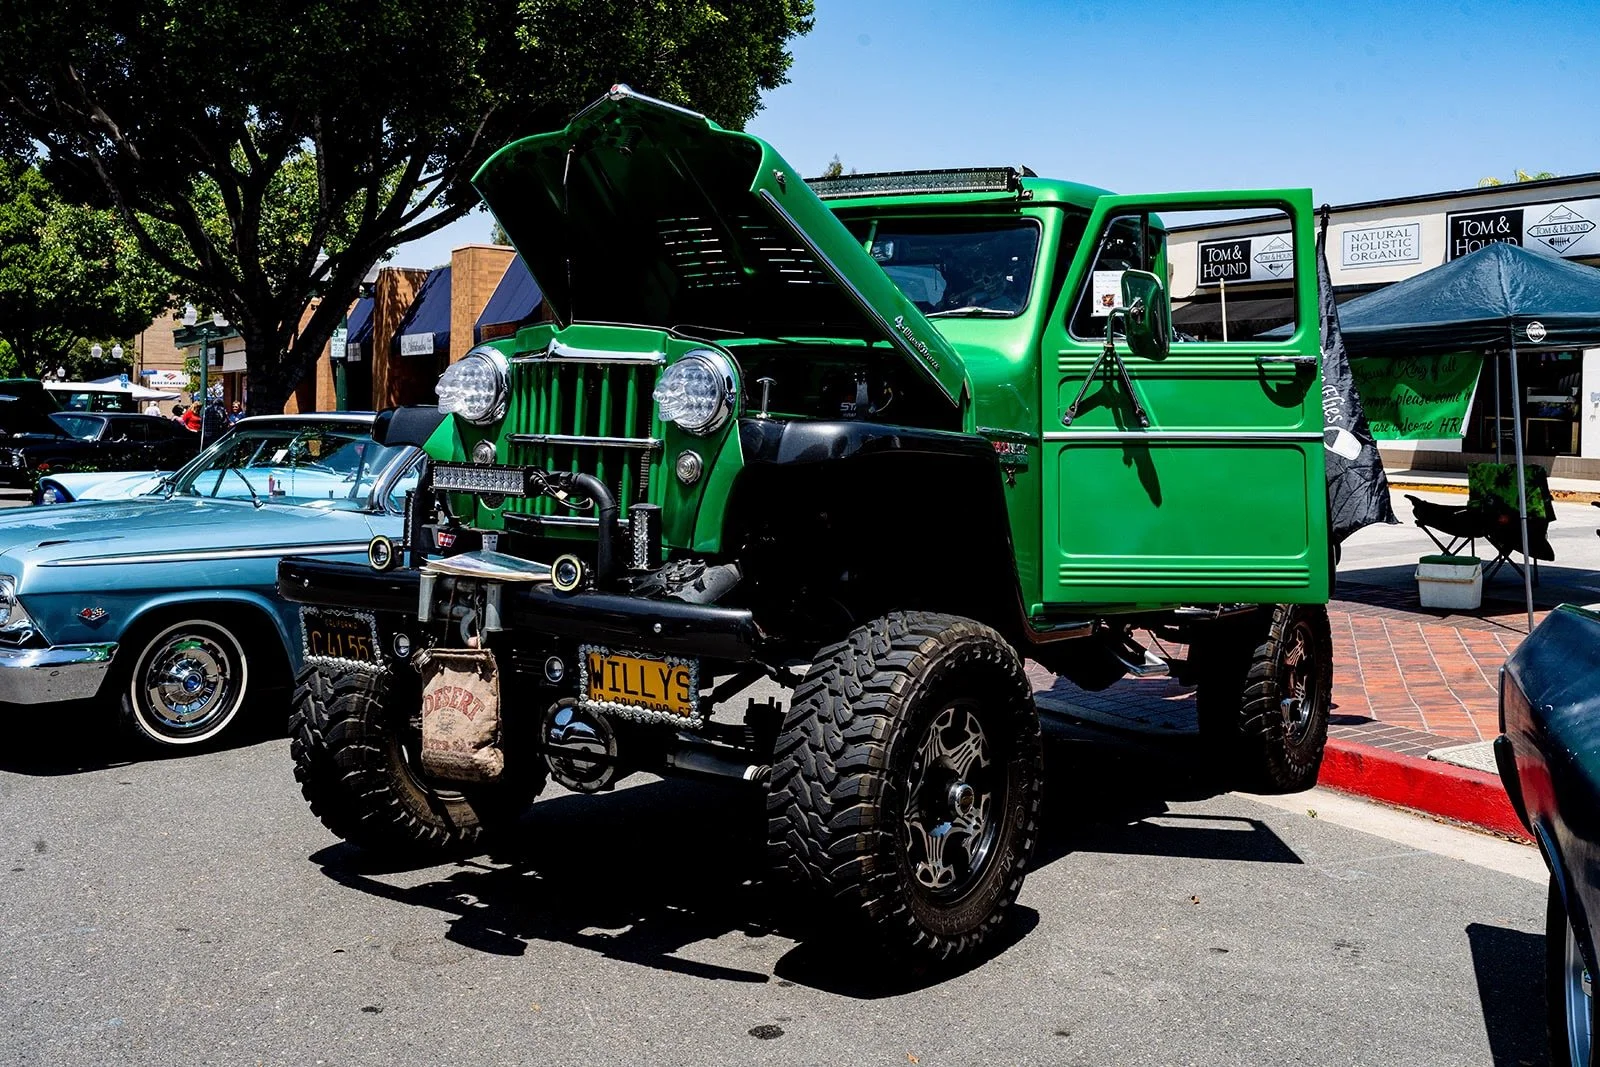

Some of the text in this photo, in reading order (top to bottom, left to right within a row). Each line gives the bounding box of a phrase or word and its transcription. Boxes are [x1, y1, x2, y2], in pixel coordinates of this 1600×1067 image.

[1459, 215, 1511, 237] TOM &
[1551, 226, 1559, 234] &
[1560, 223, 1589, 234] HOUND
[1351, 228, 1412, 243] NATURAL
[1351, 238, 1412, 252] HOLISTIC
[1455, 237, 1518, 256] HOD
[1206, 245, 1242, 262] TOM &
[1276, 252, 1293, 260] HOUN
[1350, 248, 1412, 261] ORGANIC
[1203, 262, 1248, 278] HOUND
[1373, 421, 1389, 433] are
[590, 658, 691, 702] WILLYS
[424, 685, 486, 721] DESERT
